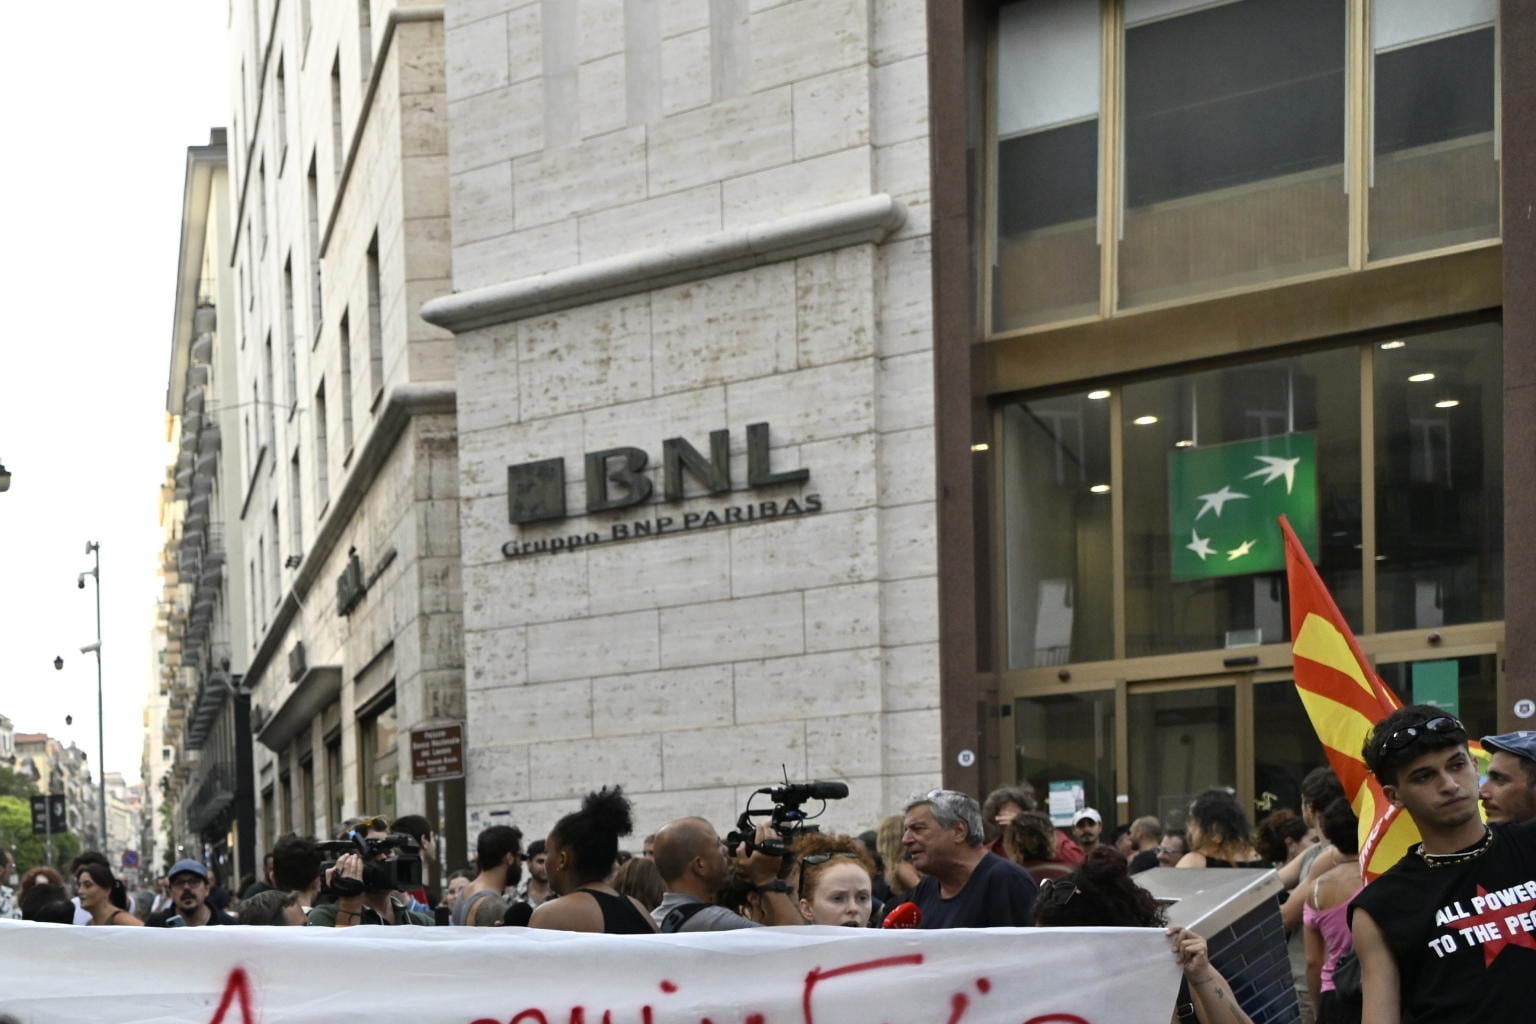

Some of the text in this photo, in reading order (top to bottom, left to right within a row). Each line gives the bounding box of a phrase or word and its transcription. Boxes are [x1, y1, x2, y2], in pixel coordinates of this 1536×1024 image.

[584, 422, 810, 514] BNL
[501, 493, 823, 558] Gruppo BNP PARIBAS
[1435, 880, 1536, 927] ALL POWER
[1428, 934, 1457, 958] TO
[1458, 922, 1503, 947] THE
